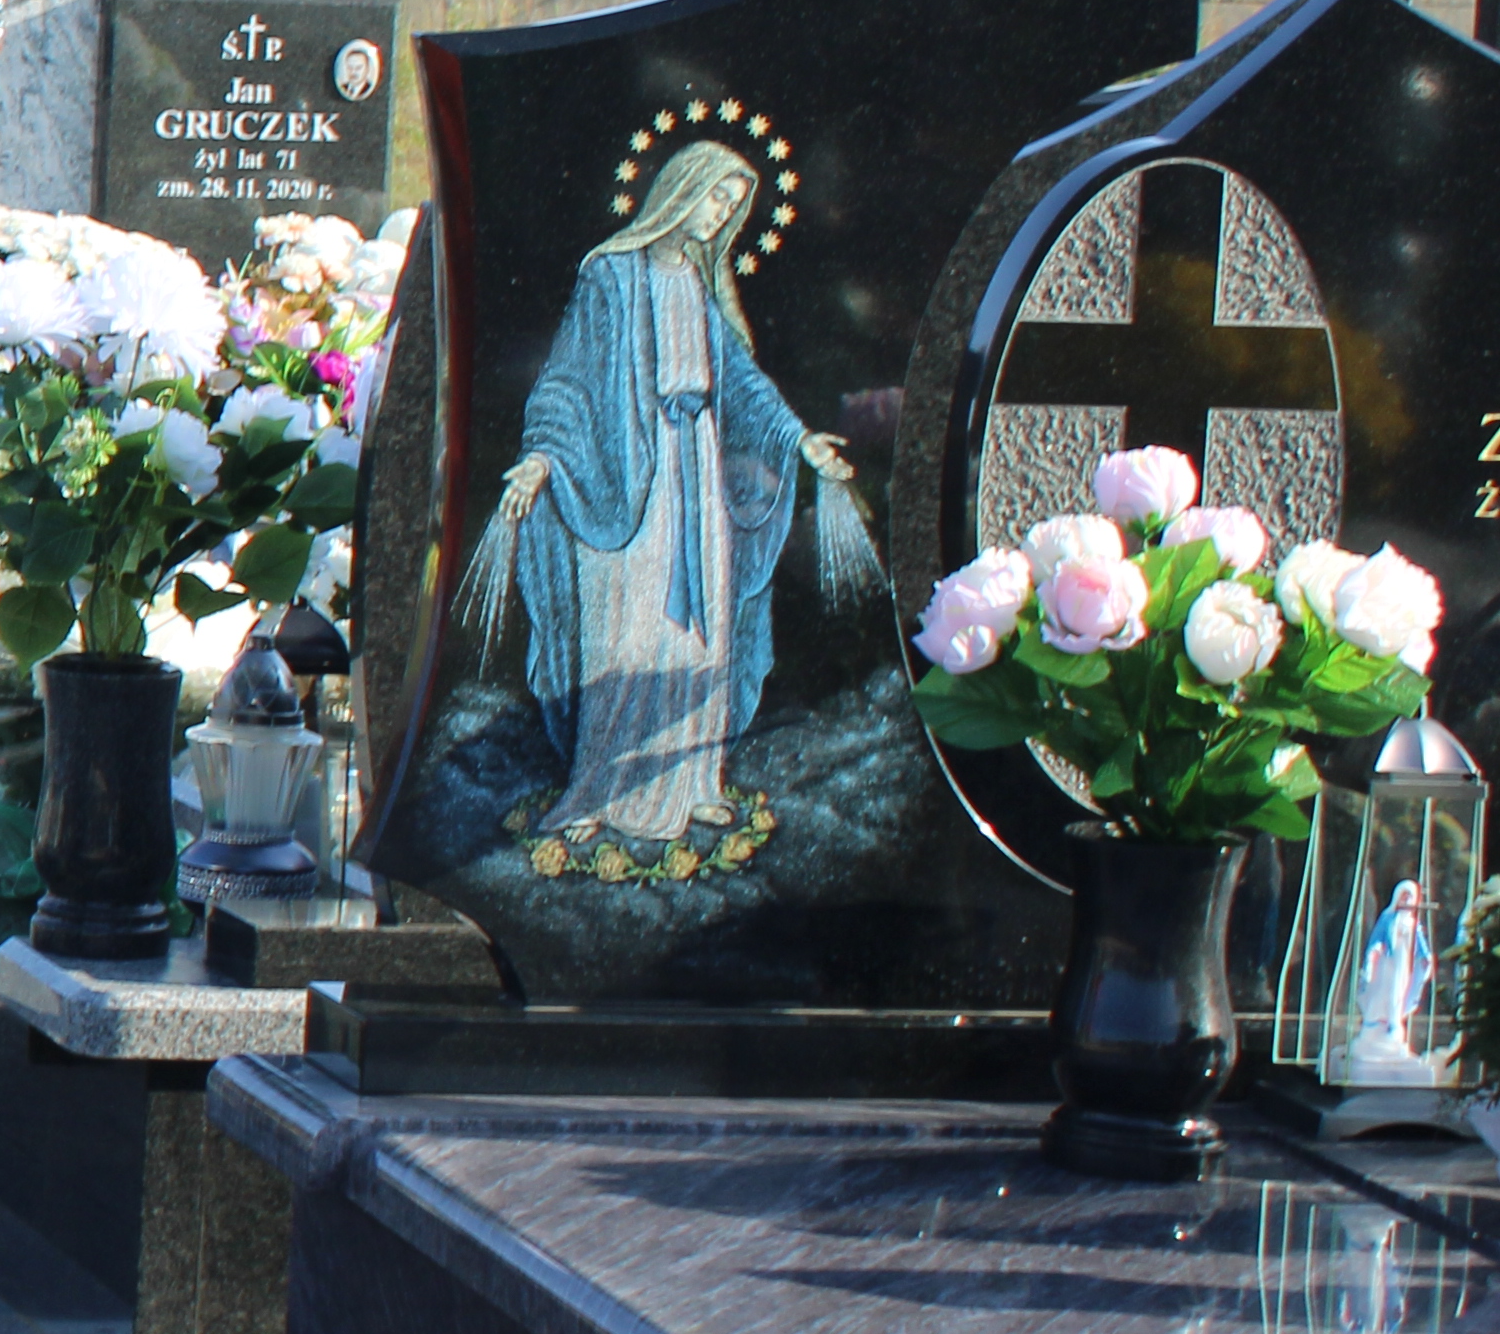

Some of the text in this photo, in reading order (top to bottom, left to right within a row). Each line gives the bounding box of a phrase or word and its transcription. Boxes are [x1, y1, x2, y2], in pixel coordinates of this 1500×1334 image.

[265, 37, 285, 61] P.
[225, 76, 275, 104] Jan
[155, 109, 341, 142] GRUCZEK
[238, 148, 266, 169] lat
[275, 149, 299, 169] 71
[157, 180, 195, 197] zm.
[200, 177, 230, 199] 28.
[235, 177, 262, 199] 11.
[266, 178, 316, 200] 2020
